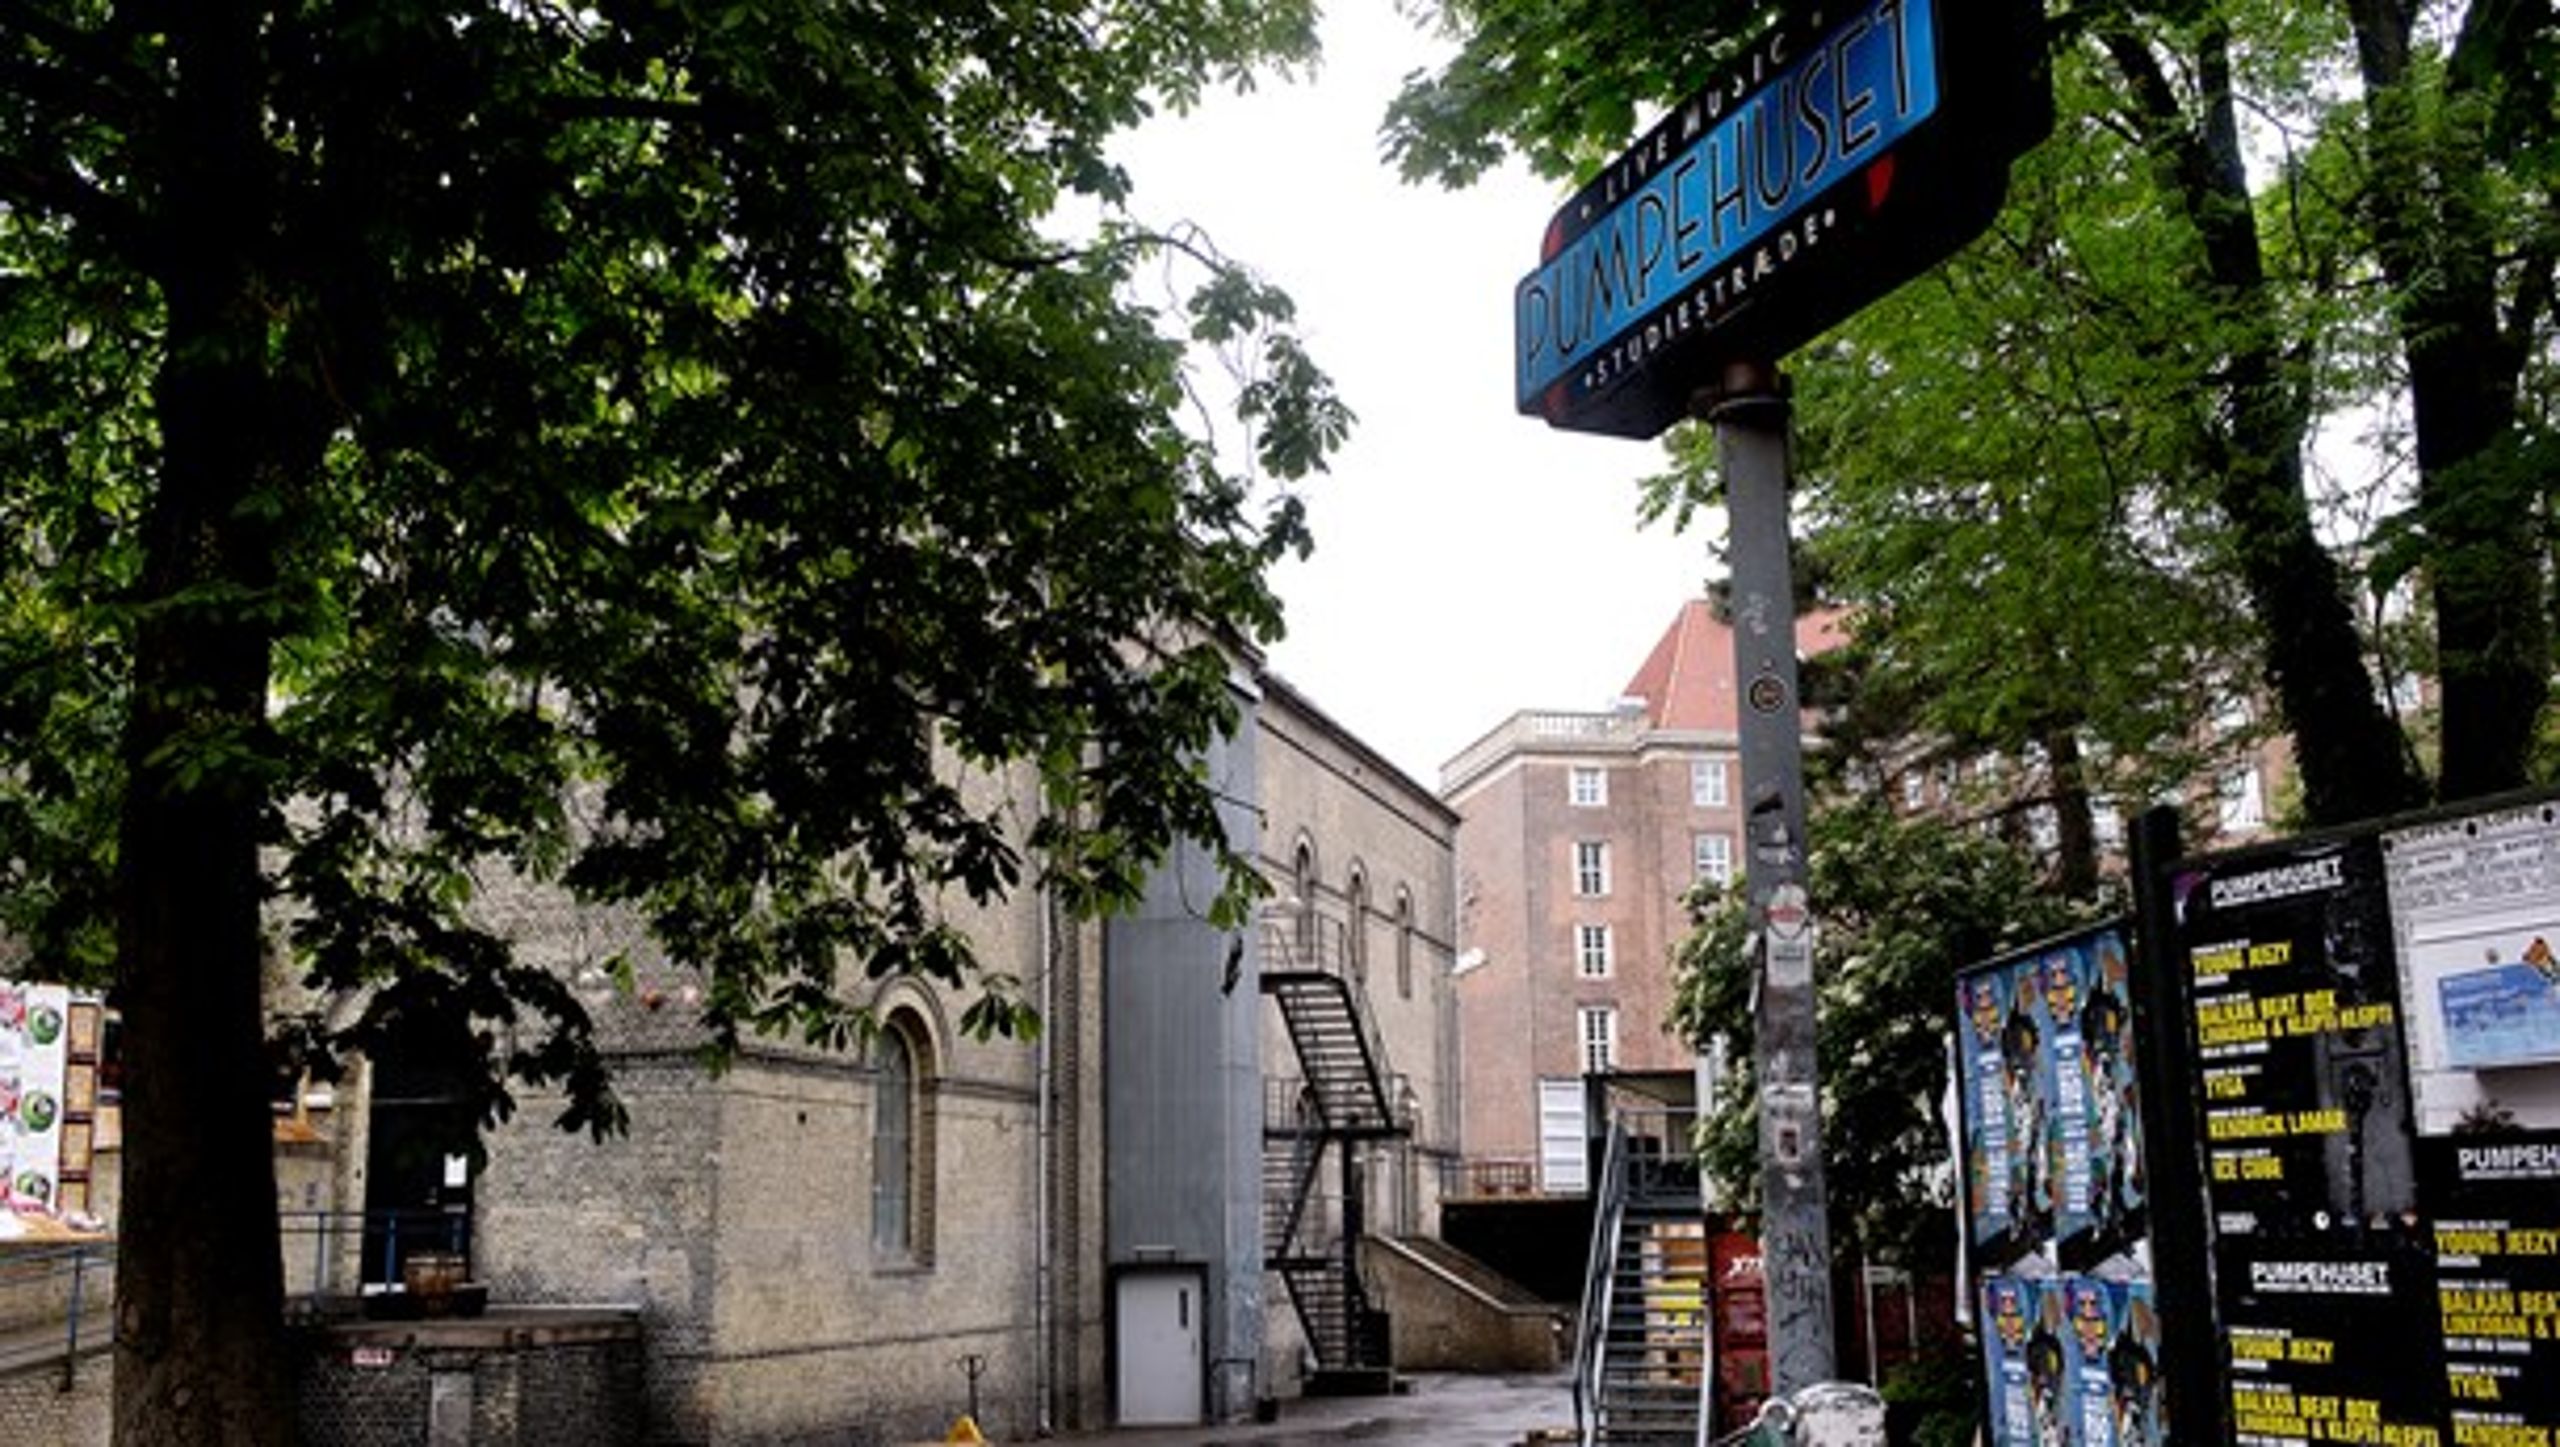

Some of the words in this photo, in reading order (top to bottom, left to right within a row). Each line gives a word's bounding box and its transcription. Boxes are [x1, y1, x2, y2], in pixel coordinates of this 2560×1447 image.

[1605, 134, 1668, 203] LIVE
[1682, 33, 1787, 141] MUSIC
[1525, 0, 1910, 382] PUMPEHUSET
[2211, 855, 2343, 901] PUMPEHUSET
[2252, 1261, 2389, 1283] PUMPEHUSET
